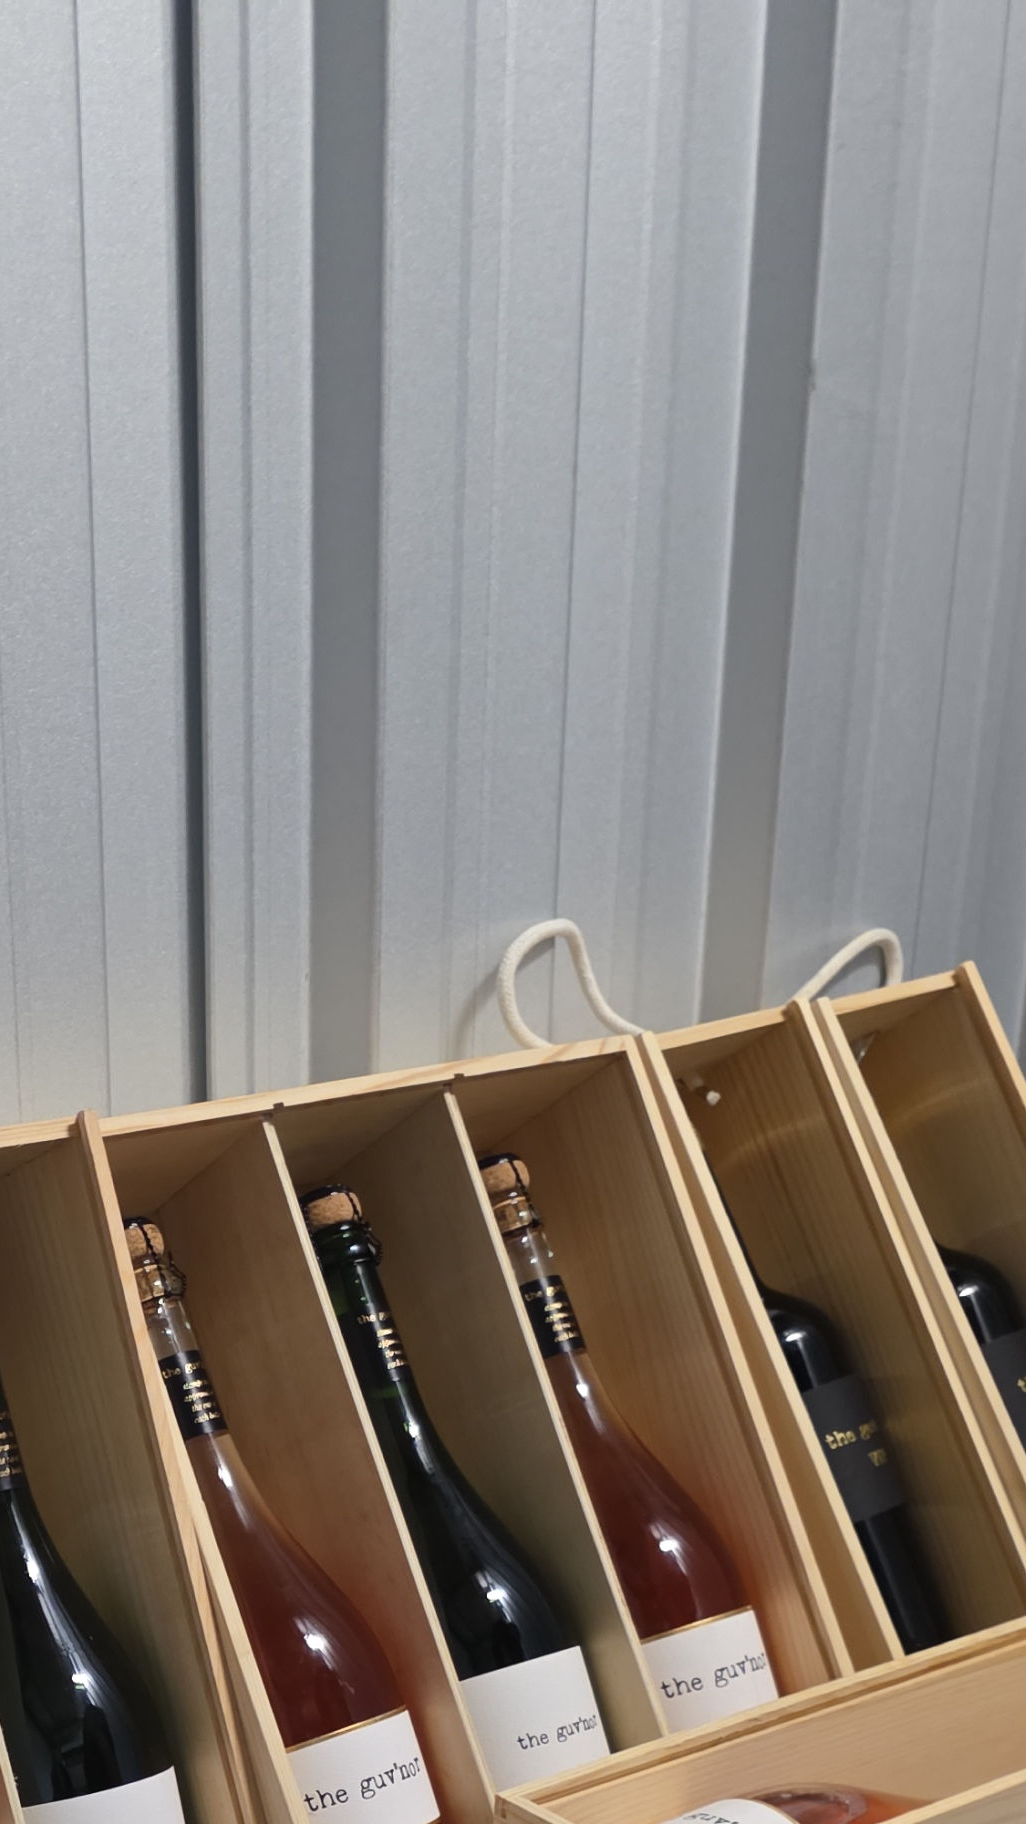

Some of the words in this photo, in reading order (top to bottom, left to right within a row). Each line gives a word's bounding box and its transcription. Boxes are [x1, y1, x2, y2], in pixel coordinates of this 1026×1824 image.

[162, 1368, 181, 1379] the
[825, 1430, 856, 1450] the
[660, 1678, 704, 1699] the
[517, 1732, 550, 1750] the
[303, 1788, 349, 1812] the
[360, 1757, 421, 1800] guv'nor
